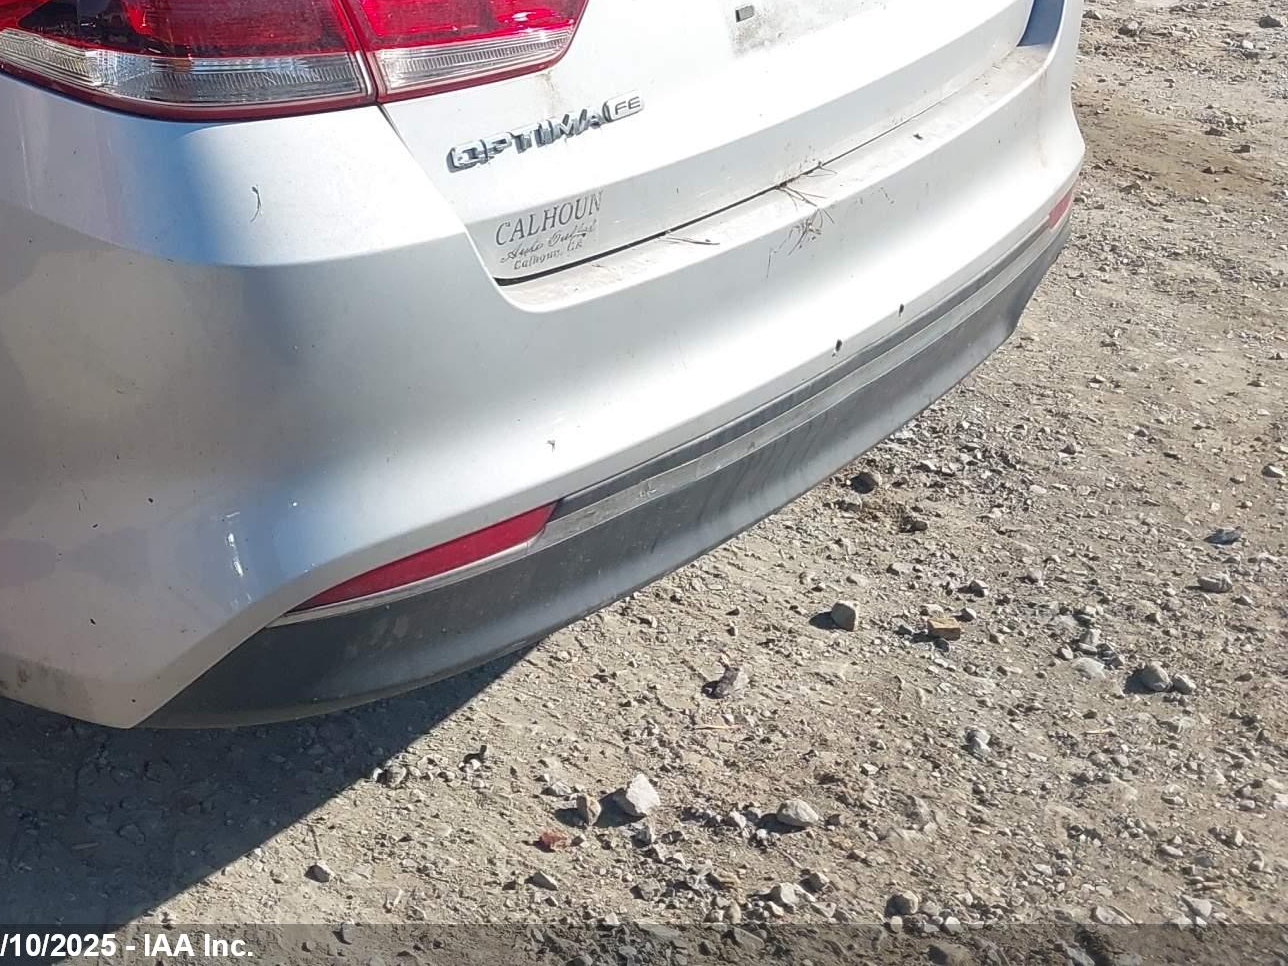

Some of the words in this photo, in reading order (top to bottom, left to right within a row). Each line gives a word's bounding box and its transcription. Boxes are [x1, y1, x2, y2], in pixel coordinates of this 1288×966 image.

[446, 108, 605, 173] OPTIMA
[614, 96, 642, 116] FE
[494, 189, 604, 246] CALHOUN
